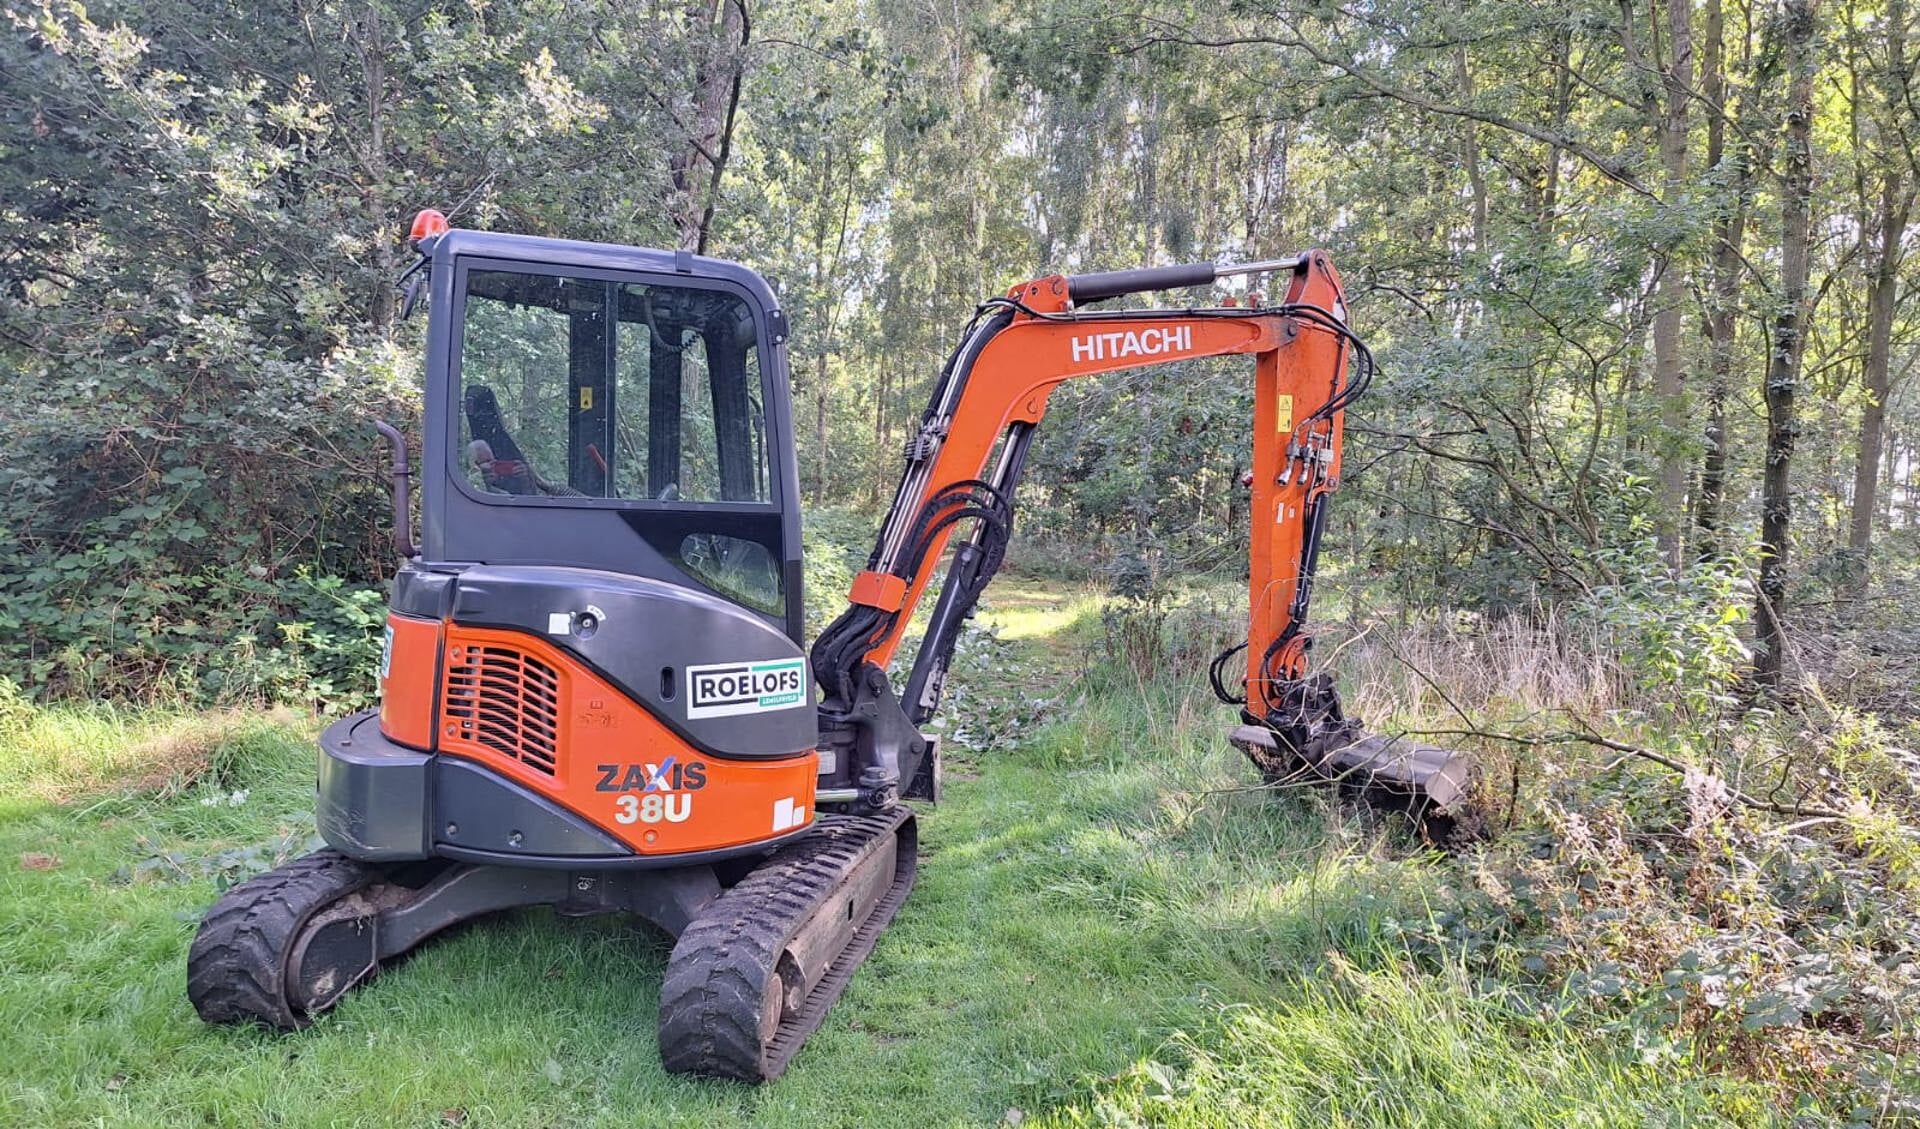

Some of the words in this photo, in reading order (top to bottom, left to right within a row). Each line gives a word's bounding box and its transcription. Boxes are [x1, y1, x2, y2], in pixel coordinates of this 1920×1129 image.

[1072, 326, 1192, 362] HITACHI
[701, 671, 799, 699] ROELOFS
[595, 756, 707, 792] ZAXIS
[615, 793, 692, 824] 38U
